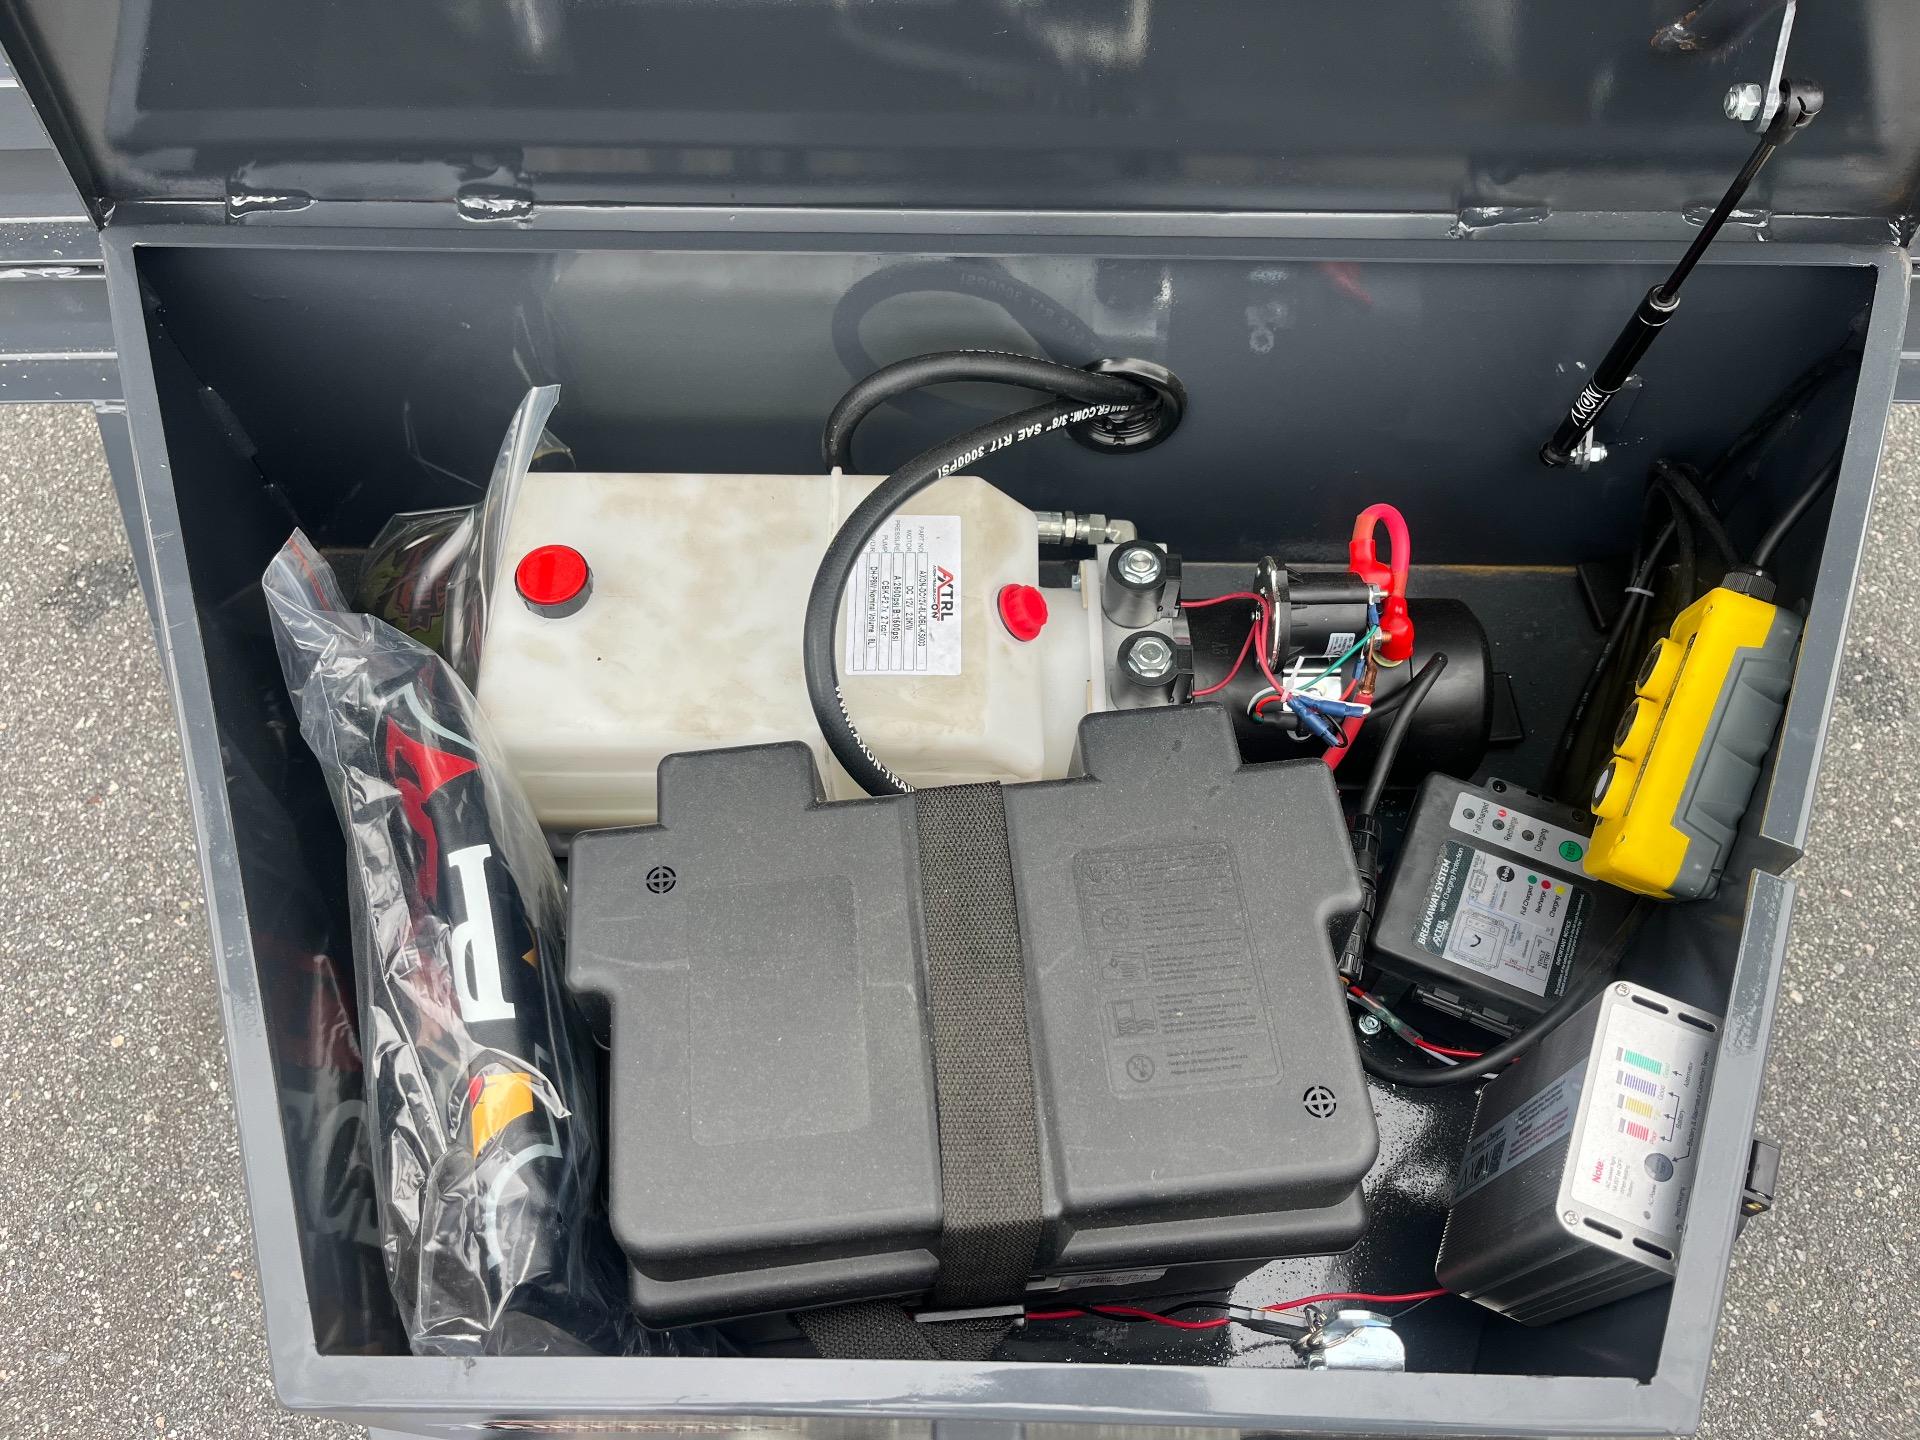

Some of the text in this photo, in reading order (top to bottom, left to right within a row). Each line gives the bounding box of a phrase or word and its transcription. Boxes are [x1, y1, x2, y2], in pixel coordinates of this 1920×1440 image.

[990, 434, 1012, 453] R17
[1018, 423, 1042, 442] SAE
[938, 446, 985, 479] 3000PSI
[906, 586, 913, 594] DC
[1472, 802, 1489, 833] Full Charged
[1504, 816, 1517, 841] Recharge
[1533, 827, 1549, 852] Charging
[1564, 843, 1576, 857] TEST
[1439, 846, 1464, 912] with Charging Protection
[1417, 858, 1451, 944] BREAKAWAY SYSTEM
[1522, 884, 1534, 906] Charged
[1535, 890, 1547, 914] Recharge
[1548, 894, 1561, 917] Charging
[1554, 938, 1567, 965] IMPORTANT
[1674, 1108, 1685, 1129] Battery
[1591, 1157, 1605, 1183] Note:
